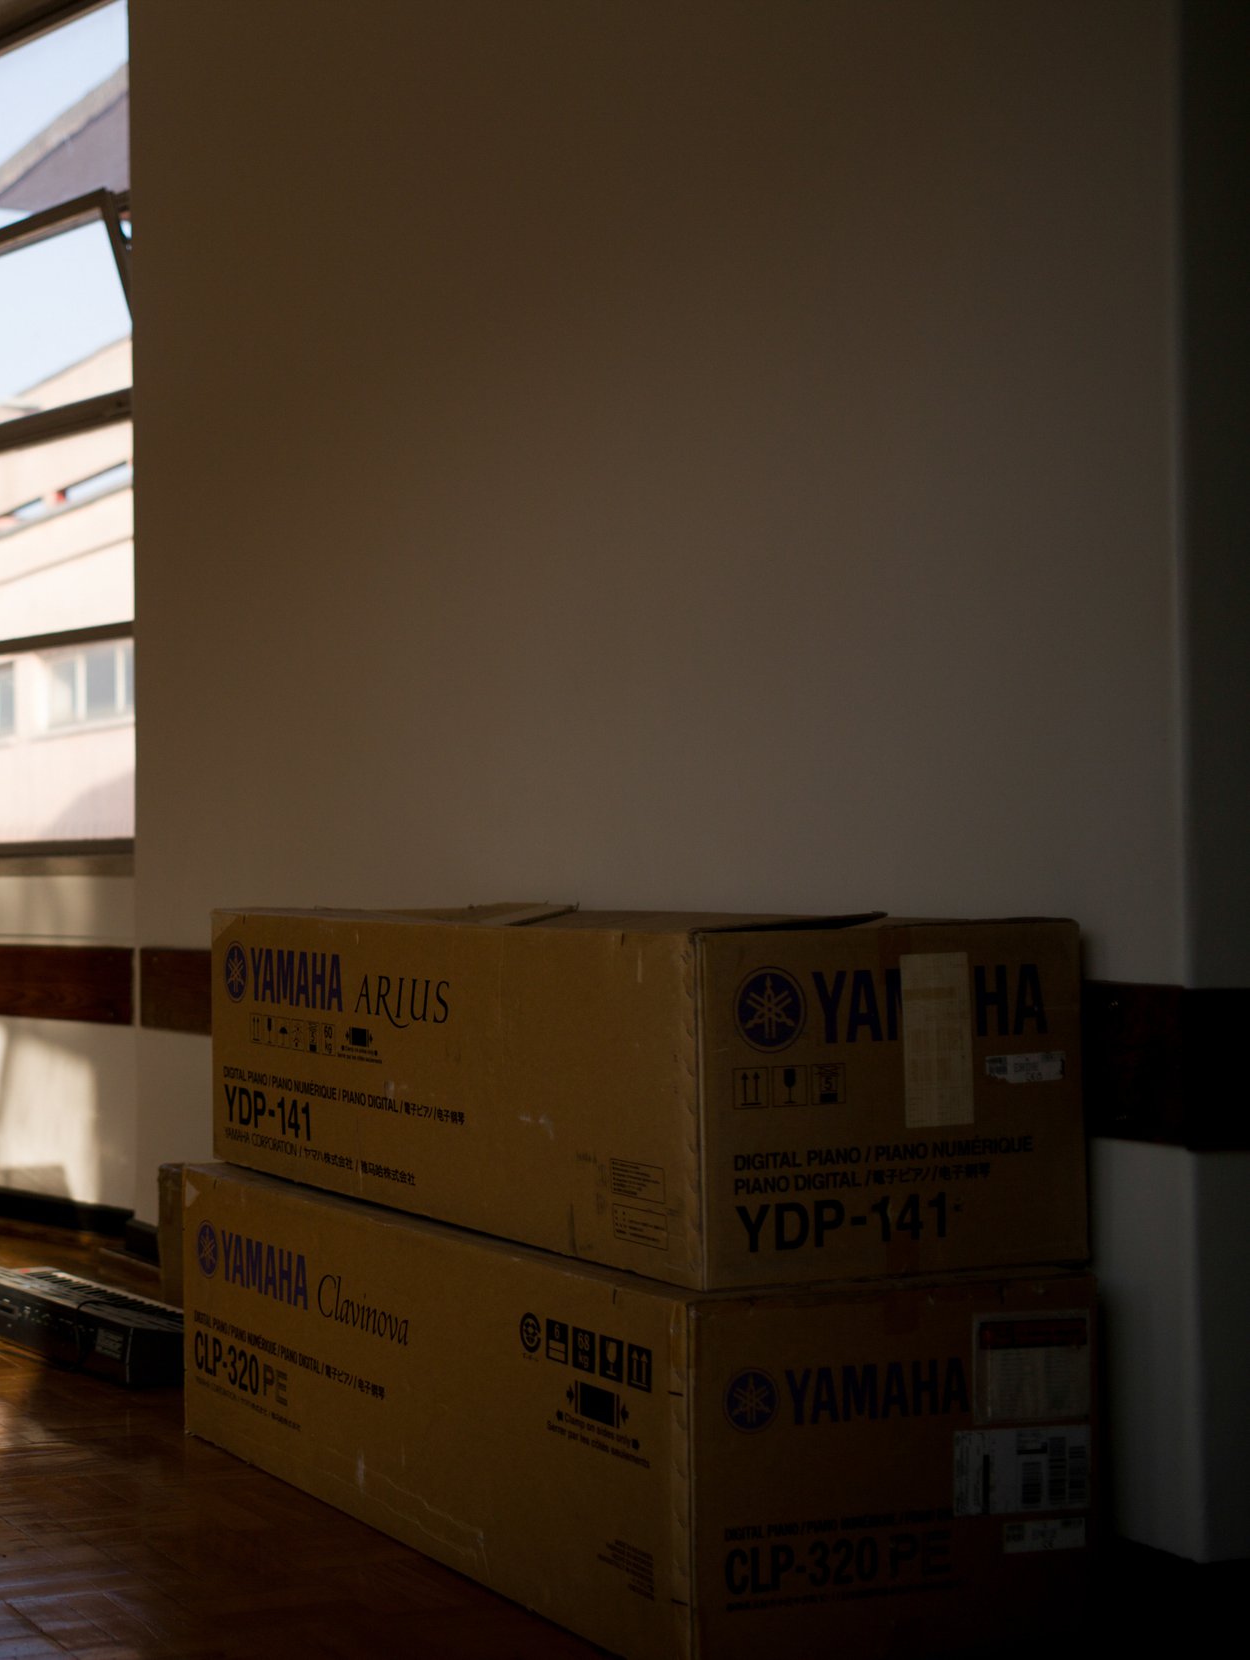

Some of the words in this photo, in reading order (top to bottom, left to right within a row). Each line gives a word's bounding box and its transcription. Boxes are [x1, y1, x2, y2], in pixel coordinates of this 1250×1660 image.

[250, 947, 343, 1012] YAMAHA
[354, 974, 450, 1029] ARIUS
[812, 963, 1048, 1043] YAHA
[223, 1065, 247, 1081] DIGITAL
[247, 1069, 267, 1087] PIANO
[272, 1073, 293, 1092] PIANO
[293, 1078, 337, 1100] NUMÉRIQUE
[342, 1090, 367, 1106] PIANO
[367, 1095, 399, 1113] DIGITAL
[224, 1084, 311, 1141] YDP-141
[224, 1127, 251, 1145] YAMAHA
[251, 1131, 297, 1157] CORPORATION
[734, 1152, 802, 1171] DIGITAL
[806, 1147, 861, 1167] PIANO
[874, 1142, 928, 1162] PIANO
[932, 1136, 1034, 1160] NUMÉRIQUE
[734, 1175, 791, 1195] PIANO
[794, 1171, 861, 1191] DIGITAL
[735, 1191, 947, 1253] YDP-141
[221, 1229, 309, 1311] YAMAHA
[317, 1274, 410, 1346] Clavinova
[553, 1325, 561, 1340] 6
[194, 1310, 212, 1329] DIGITAL
[212, 1317, 228, 1333] PIANO
[230, 1323, 247, 1342] PIANO
[280, 1345, 298, 1364] PIANO
[298, 1352, 320, 1374] DIGITAL
[194, 1330, 259, 1396] CLP-320
[263, 1362, 288, 1407] PE
[577, 1332, 591, 1351] 68
[784, 1356, 970, 1426] YAMAHA
[586, 1421, 595, 1433] on
[724, 1525, 766, 1542] DIGITAL
[725, 1536, 878, 1595] CLP-320
[888, 1530, 953, 1580] PE
